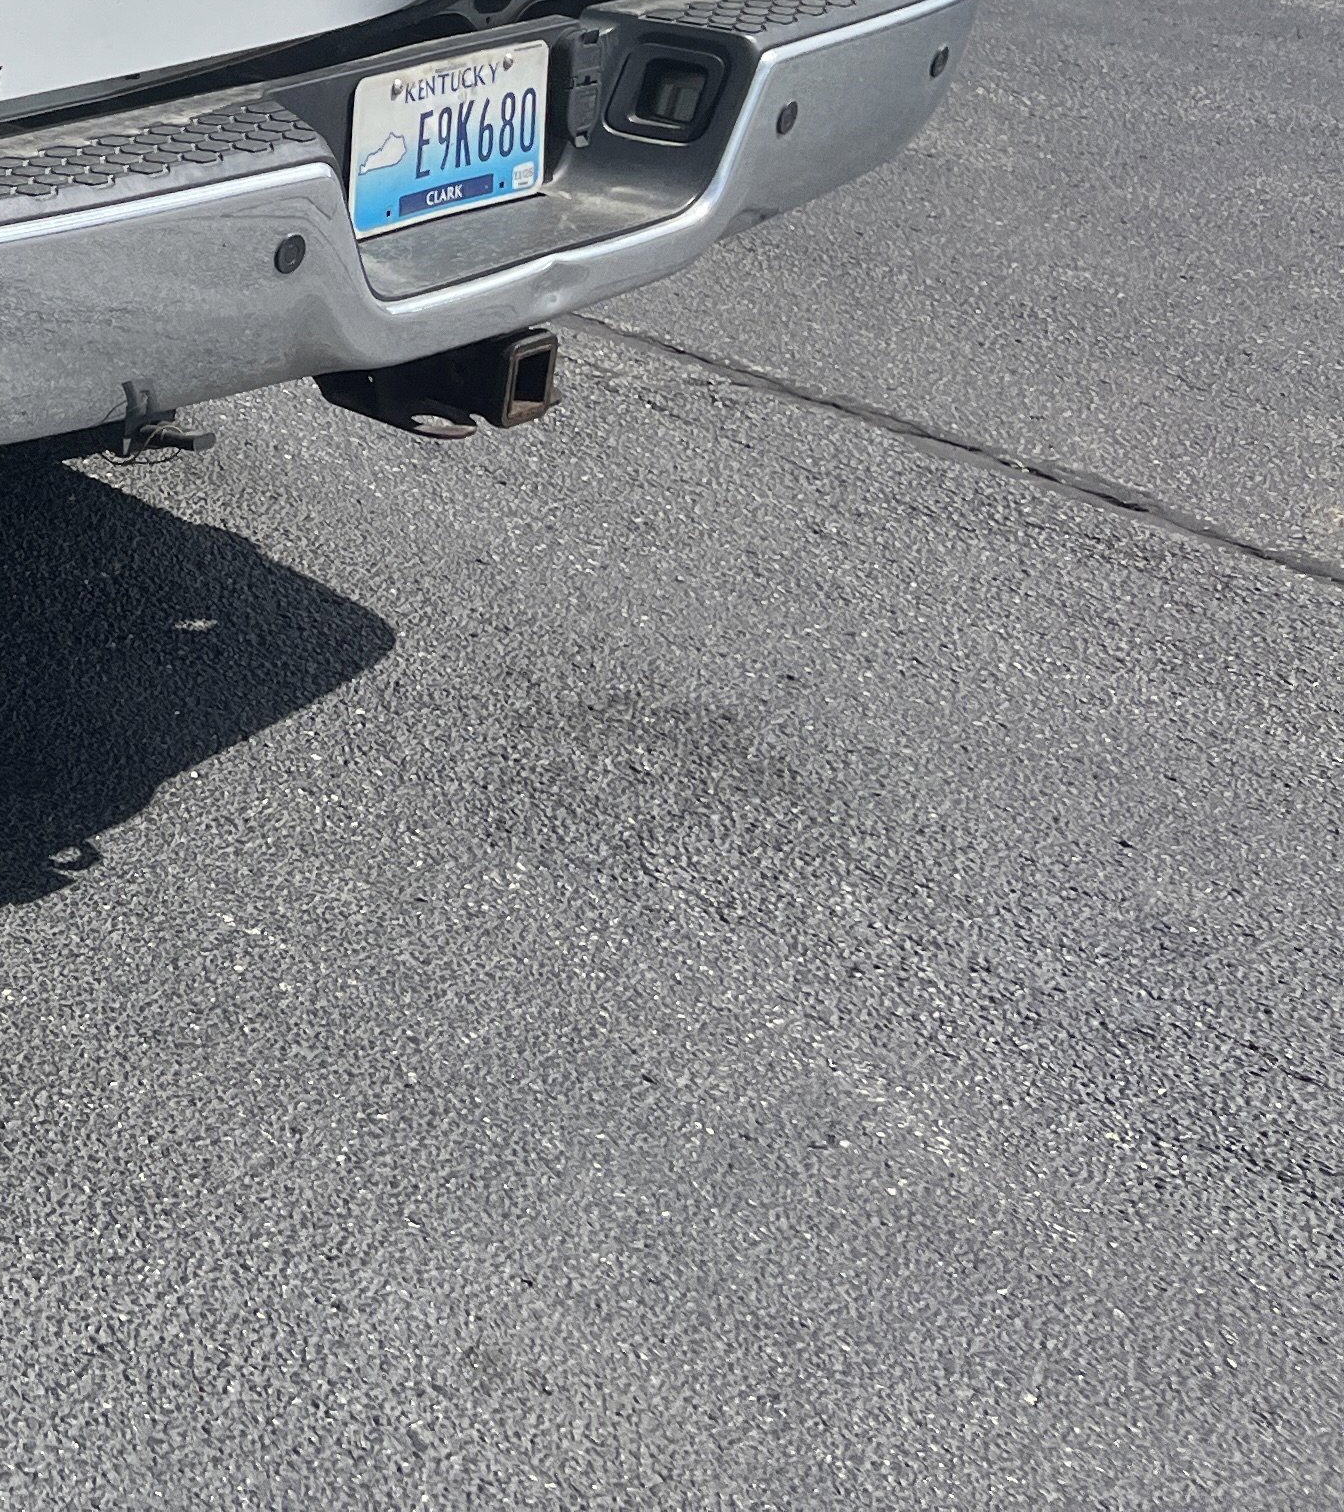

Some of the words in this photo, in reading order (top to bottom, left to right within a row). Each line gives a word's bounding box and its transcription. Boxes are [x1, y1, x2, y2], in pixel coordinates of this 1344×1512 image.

[404, 61, 500, 104] KENTUCKY
[415, 87, 537, 179] E9K680
[425, 183, 463, 206] CLARK
